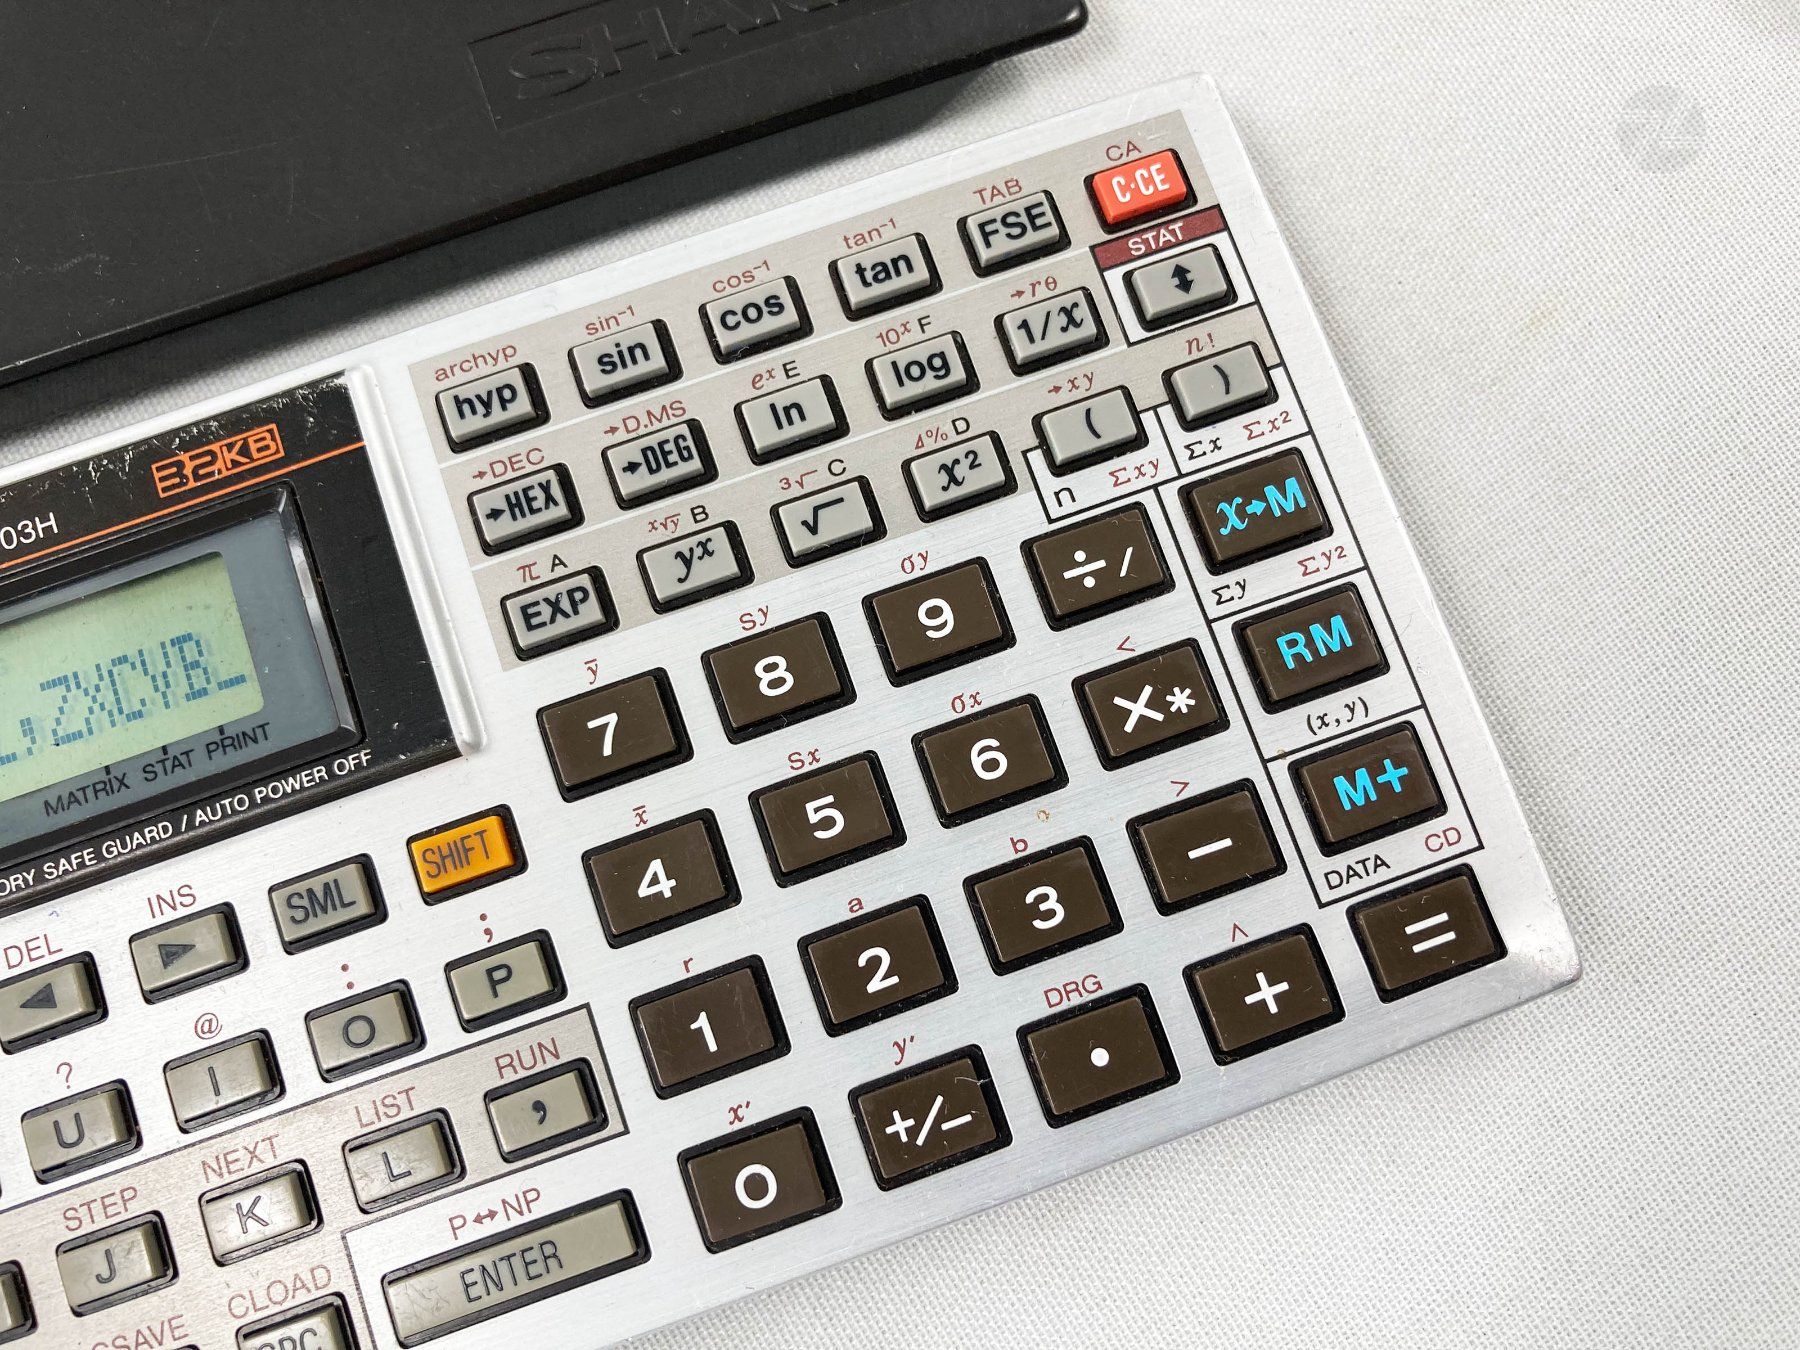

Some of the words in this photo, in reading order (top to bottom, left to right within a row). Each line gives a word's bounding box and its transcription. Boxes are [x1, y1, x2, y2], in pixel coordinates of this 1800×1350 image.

[1104, 140, 1142, 163] CA
[973, 178, 1023, 205] TAB
[978, 202, 1052, 249] FSE
[1127, 223, 1186, 257] STAT
[854, 251, 915, 289] tan
[719, 294, 786, 332] cos
[917, 315, 932, 335] F
[434, 344, 518, 383] archyp
[597, 339, 651, 376] sin
[783, 360, 801, 379] E
[890, 350, 952, 388] log
[453, 383, 518, 420] hyp
[621, 400, 688, 435] D.MS
[770, 400, 806, 431] ln
[952, 416, 971, 436] D
[154, 427, 282, 496] 32KB
[488, 446, 547, 481] DEC
[642, 432, 695, 476] DEG
[827, 459, 847, 477] C
[504, 478, 561, 524] HEX
[690, 504, 711, 525] B
[1053, 486, 1077, 509] n
[0, 511, 58, 550] 03H
[550, 554, 569, 573] A
[519, 585, 591, 633] EXP
[917, 598, 955, 639] 9
[1276, 614, 1354, 671] RM
[754, 654, 795, 698] 8
[587, 712, 620, 758] 7
[43, 768, 131, 817] MATRIX
[142, 745, 196, 783] STAT
[206, 722, 273, 762] PRINT
[969, 737, 1009, 781] 6
[1332, 757, 1409, 812] M+
[42, 847, 98, 880] SAFE
[102, 819, 174, 859] GUARD
[194, 793, 251, 827] AUTO
[254, 766, 329, 805] POWER
[332, 751, 374, 777] OFF
[805, 794, 846, 841] 5
[421, 829, 490, 881] SHIFT
[1010, 835, 1029, 855] b
[1423, 826, 1463, 854] CD
[636, 857, 677, 899] 4
[1323, 853, 1391, 891] DATA
[147, 885, 197, 919] INS
[286, 877, 357, 925] SML
[847, 896, 865, 915] a
[1023, 885, 1066, 931] 3
[3, 932, 64, 970] DEL
[683, 955, 694, 975] r
[857, 945, 900, 994] 2
[484, 963, 514, 999] P
[1043, 972, 1104, 1011] DRG
[193, 1012, 223, 1041] @
[342, 1014, 376, 1050] O
[689, 1011, 719, 1054] 1
[56, 1062, 74, 1090] ?
[492, 1037, 561, 1080] RUN
[208, 1065, 222, 1097] I
[353, 1086, 419, 1130] LIST
[52, 1111, 85, 1150] U
[200, 1134, 282, 1184] NEXT
[381, 1150, 413, 1183] L
[62, 1186, 140, 1233] STEP
[235, 1194, 271, 1235] K
[95, 1248, 118, 1285] J
[458, 1240, 564, 1302] ENTER
[226, 1263, 333, 1321] CLOAD
